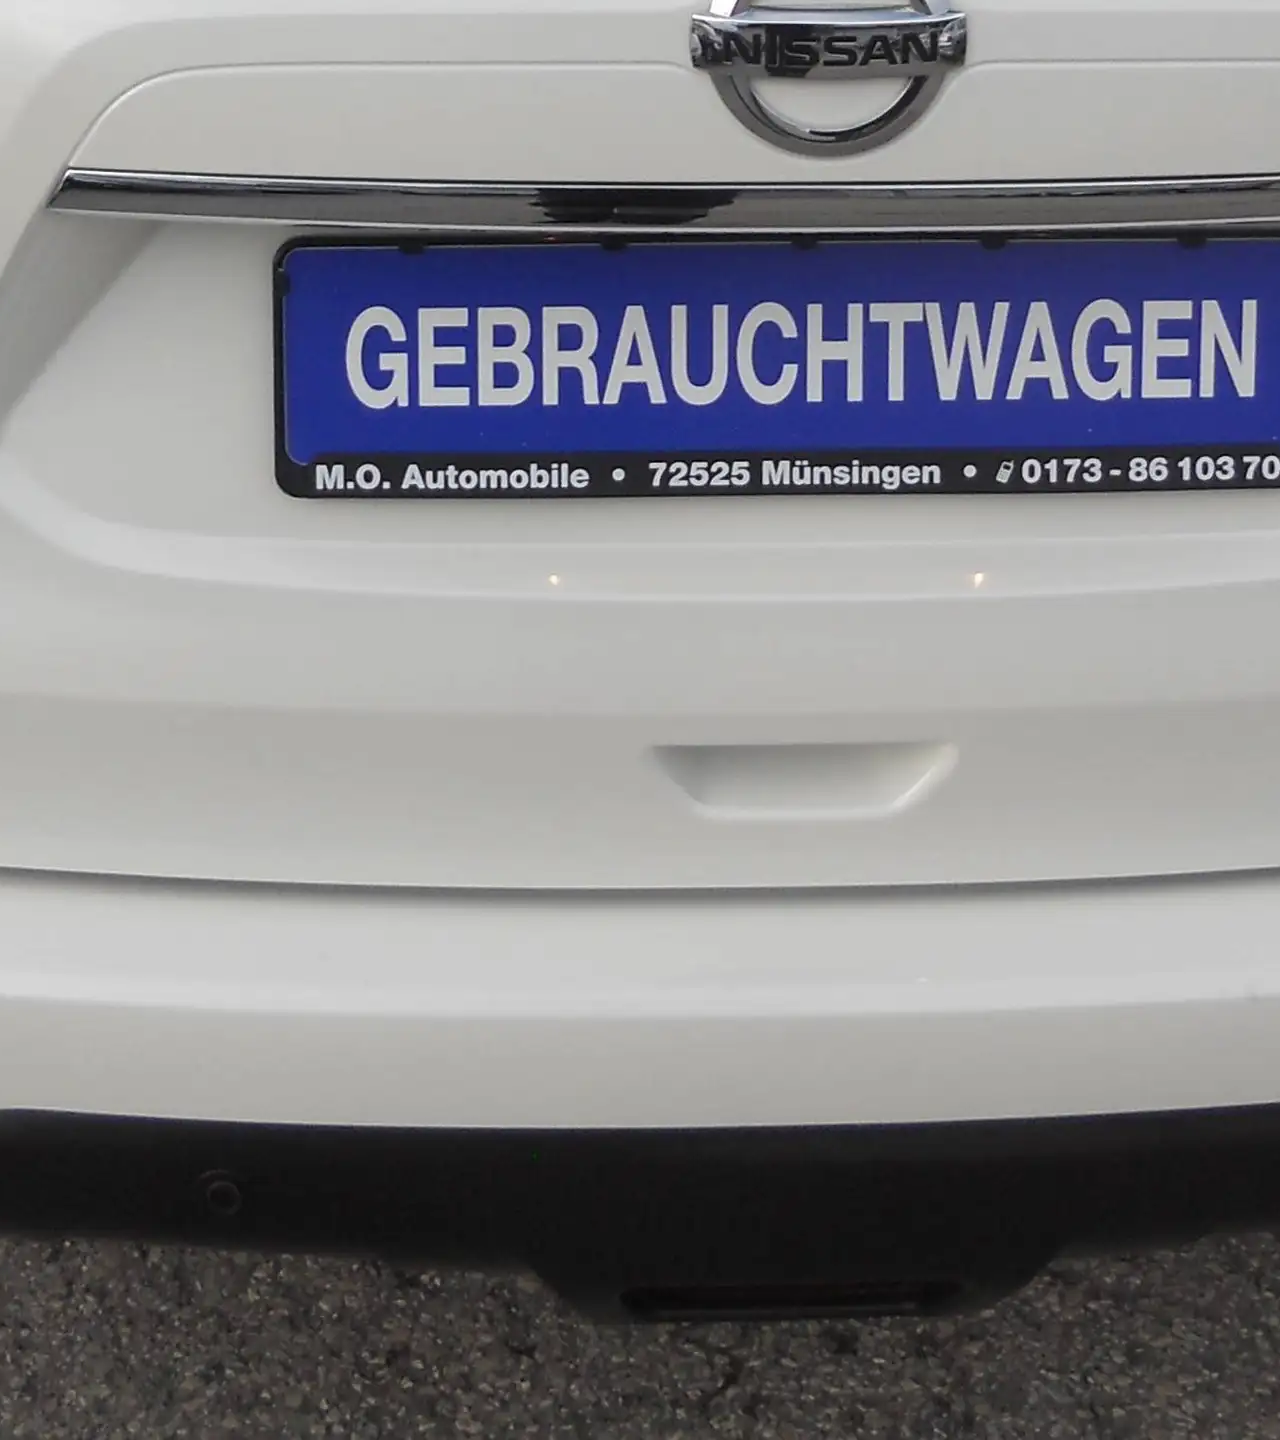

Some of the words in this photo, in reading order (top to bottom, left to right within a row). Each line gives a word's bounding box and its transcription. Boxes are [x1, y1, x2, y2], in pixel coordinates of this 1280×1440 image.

[722, 32, 940, 67] NISSAN
[346, 299, 1259, 408] GEBRAUCHTWAGEN
[315, 463, 391, 490] M.O.
[401, 463, 590, 490] Automobile
[648, 461, 751, 487] 72525
[761, 460, 942, 491] Münsingen
